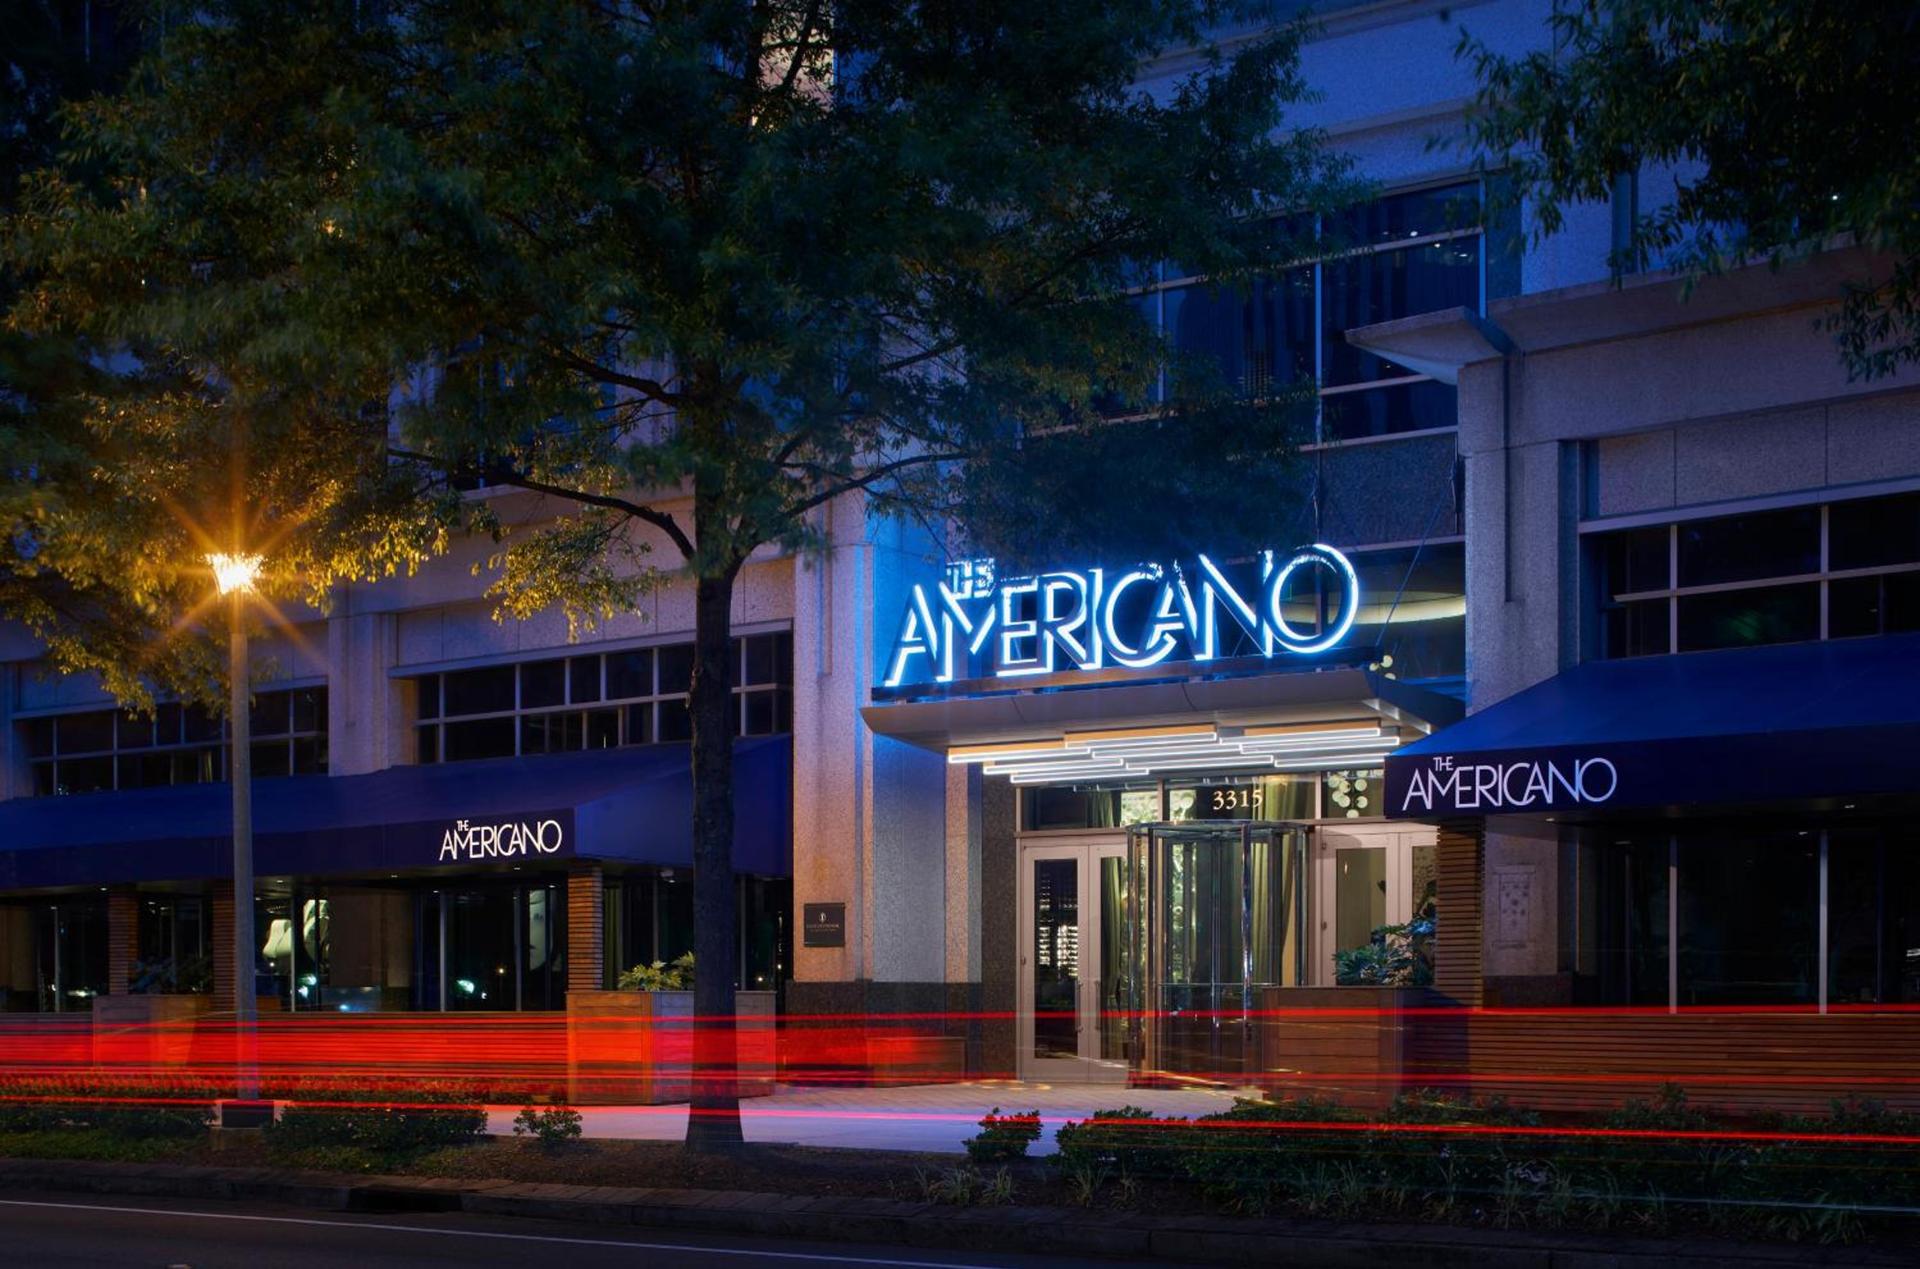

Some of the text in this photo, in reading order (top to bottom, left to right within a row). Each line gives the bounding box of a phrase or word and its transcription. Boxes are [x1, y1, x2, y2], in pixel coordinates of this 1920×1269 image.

[884, 543, 1360, 687] AMERICANO
[1433, 756, 1453, 771] THE
[1212, 788, 1263, 810] 3315
[1402, 757, 1617, 811] AMERICANO
[439, 820, 562, 861] AMERICANO
[456, 820, 469, 831] THE
